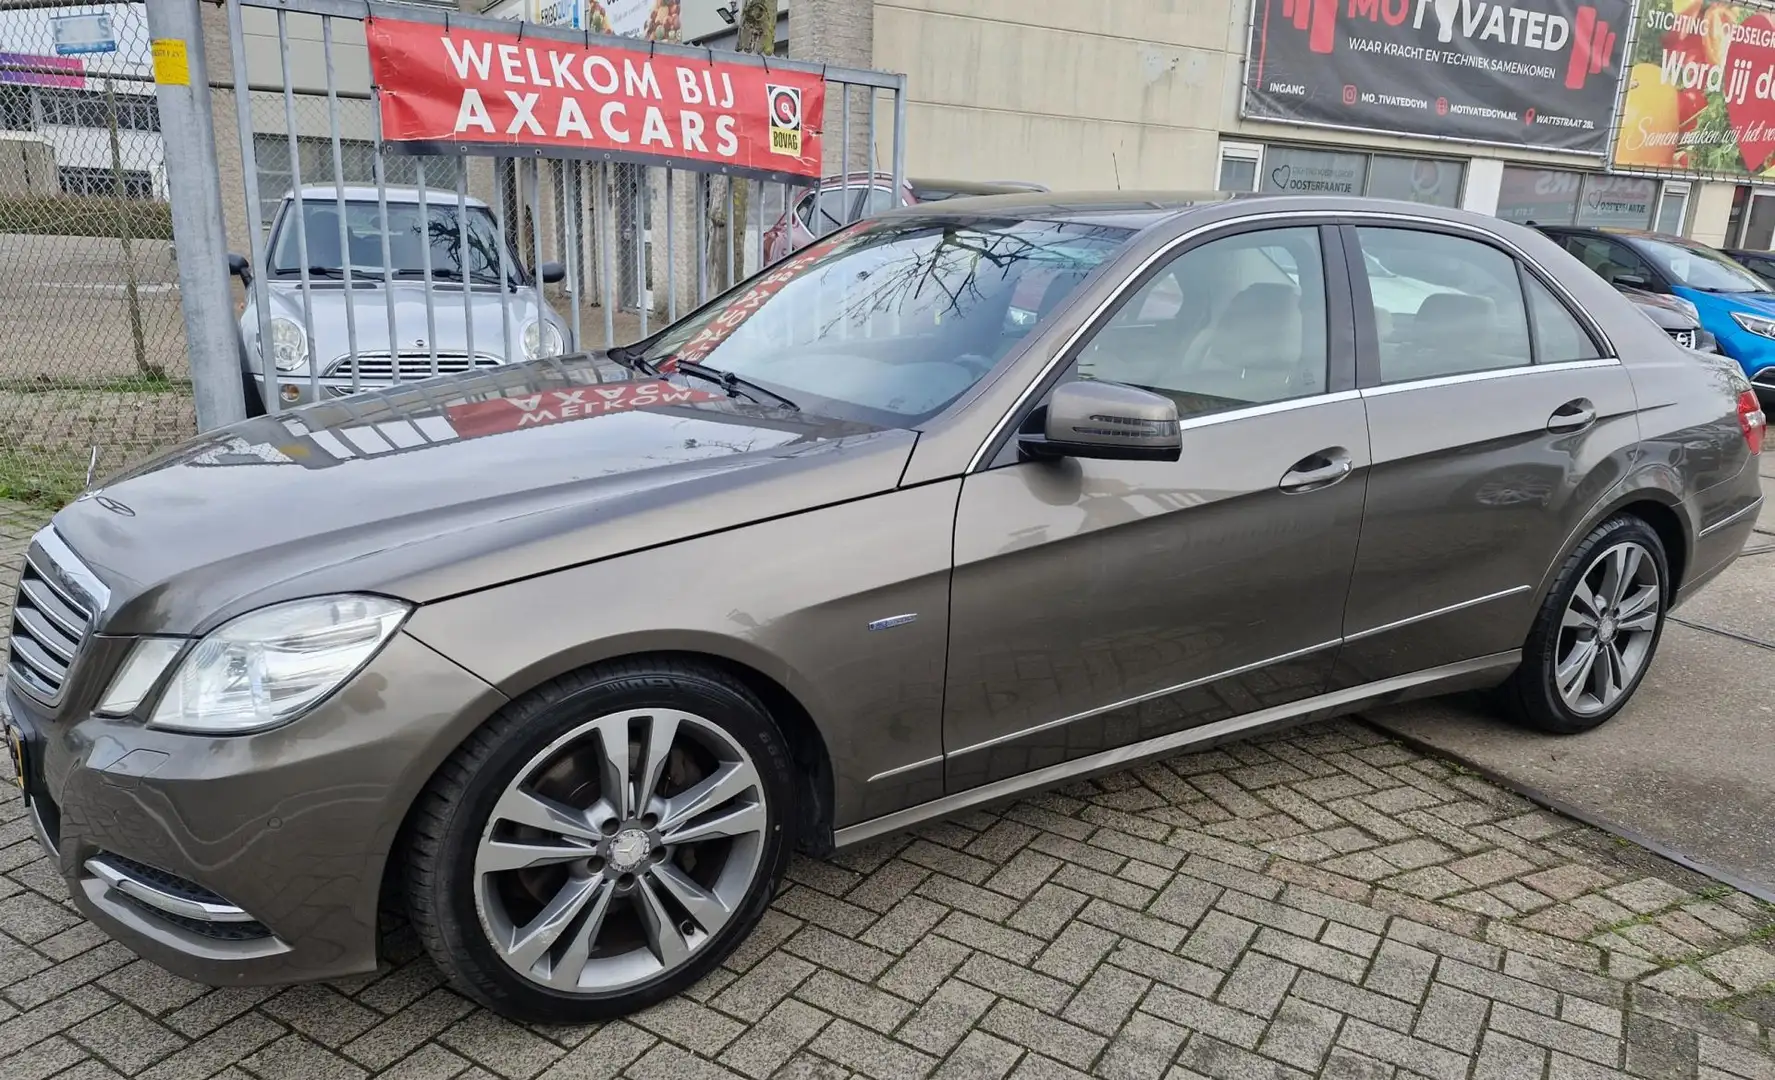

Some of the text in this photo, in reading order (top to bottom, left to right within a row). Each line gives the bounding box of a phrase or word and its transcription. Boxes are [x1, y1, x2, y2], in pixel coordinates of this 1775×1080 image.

[1647, 10, 1709, 35] STICHTING
[1349, 37, 1556, 79] WAAR KRACHT EN TECHNIEK SAMENKOMEN
[1661, 34, 1731, 92] Word
[1725, 59, 1752, 104] jij
[440, 37, 735, 109] WELKOM BIJ
[1270, 82, 1305, 95] INGANG
[1361, 92, 1428, 109] MO_TIVATEDGYM
[453, 88, 738, 157] AXACARS
[1450, 104, 1518, 121] MOTIVATEDGYM.NL
[1536, 115, 1583, 128] WATTSTRAAT
[773, 131, 798, 150] BOVAG
[1626, 117, 1677, 150] Samen
[1679, 121, 1719, 144] maken
[1721, 125, 1742, 153] wij
[1742, 120, 1766, 143] het
[1290, 179, 1352, 193] OOSTERFAANTJE
